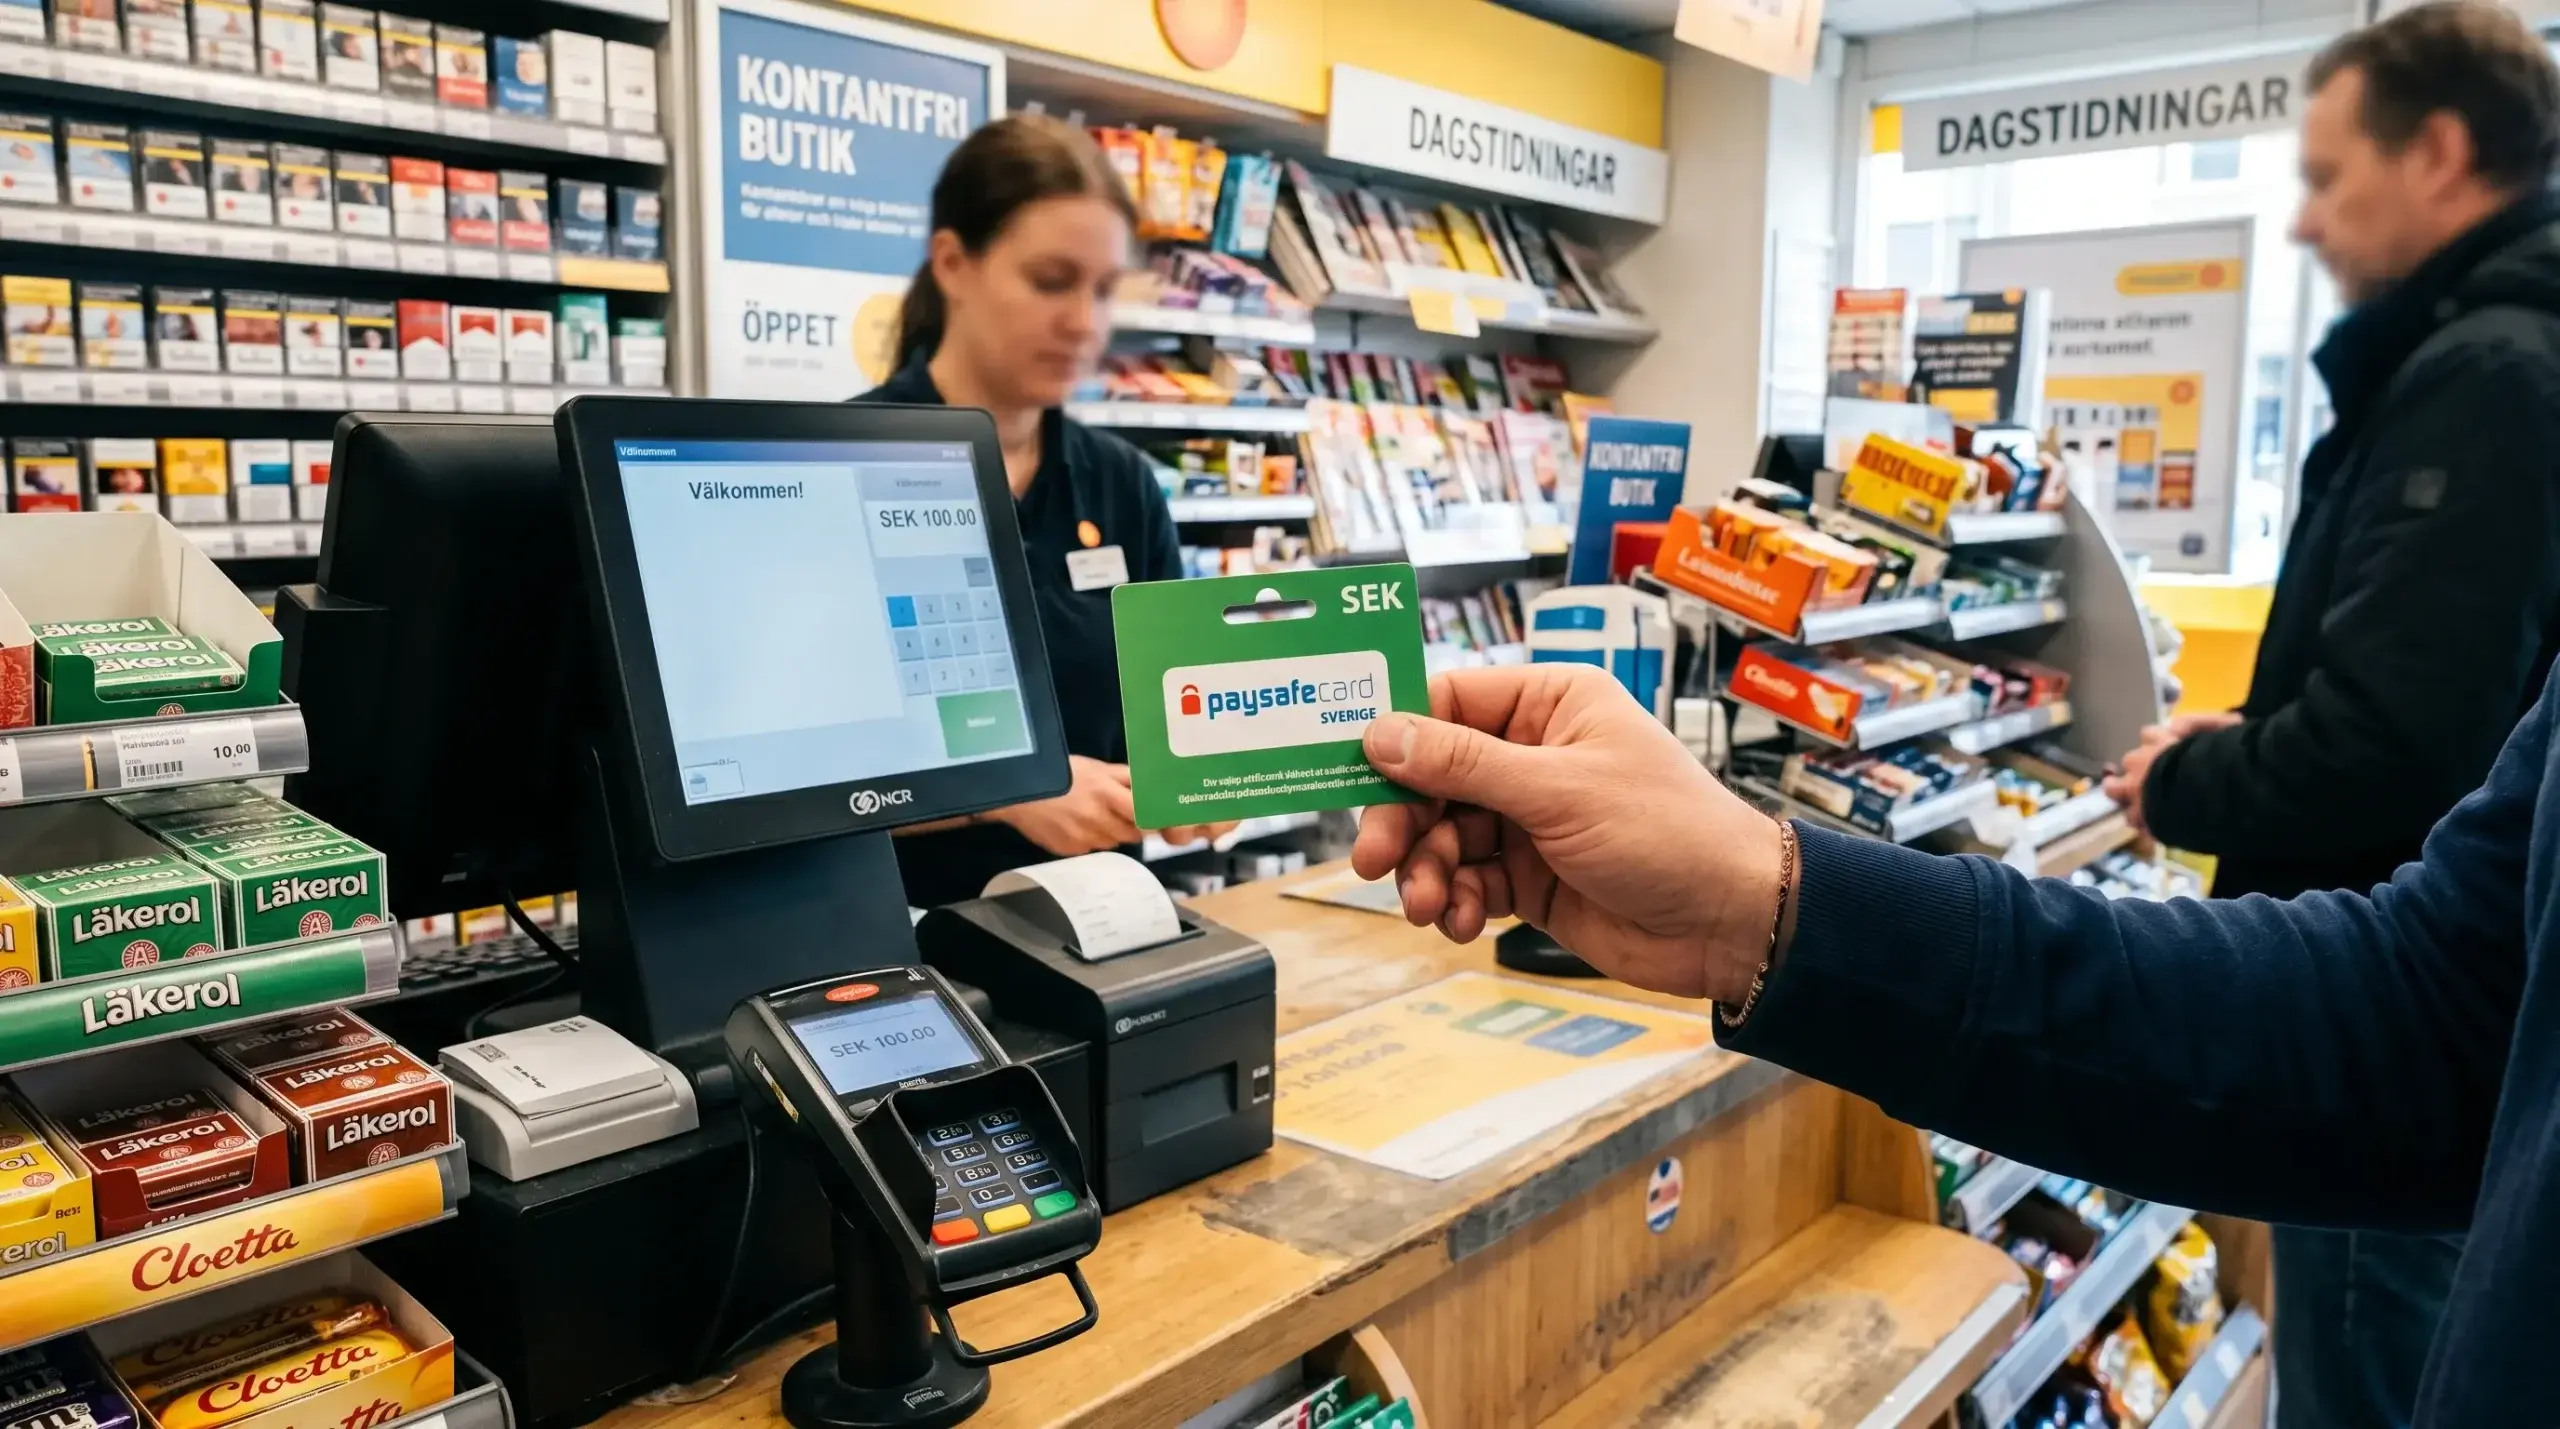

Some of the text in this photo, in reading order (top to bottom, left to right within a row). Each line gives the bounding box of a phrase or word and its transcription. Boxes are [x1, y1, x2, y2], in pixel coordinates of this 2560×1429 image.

[738, 54, 969, 140] KONTANTFRI
[1939, 77, 2290, 156] DAGSTIDNINGAR
[740, 112, 856, 176] BUTIK
[1409, 105, 1616, 195] DAGSTIDNINGAR
[743, 299, 838, 347] ÖPPET
[1589, 442, 1684, 472] KONTANTFRI
[688, 481, 804, 500] Välkommen!
[1609, 478, 1656, 506] BUTIK
[880, 508, 976, 528] SEK 100.00
[1341, 581, 1404, 614] SEK
[42, 619, 156, 638] äkerol
[94, 653, 217, 674] äkerol
[1208, 672, 1374, 720] paysafecard
[1321, 707, 1376, 724] SVERIGE
[213, 743, 251, 760] 10,00
[881, 789, 913, 807] NCR
[256, 870, 368, 912] Läkerol
[73, 896, 201, 943] Läkerol
[82, 972, 241, 1034] Läkerol
[236, 1019, 347, 1051] Läkerol
[830, 1026, 937, 1059] SEK 100.00
[284, 1054, 401, 1090] Läkerol
[79, 1093, 196, 1129] Läkerol
[326, 1099, 437, 1151] Läkerol
[988, 1115, 1001, 1126] 3
[100, 1120, 227, 1161] Läkerol
[937, 1128, 950, 1140] 2
[1002, 1135, 1014, 1146] 6
[951, 1148, 965, 1160] 5
[1014, 1155, 1027, 1166] 9
[965, 1169, 978, 1180] 8
[979, 1189, 992, 1201] 0
[0, 1231, 67, 1264] erol
[132, 1223, 300, 1292] Cloetta
[142, 1302, 319, 1366] Cloetta
[198, 1344, 378, 1414] Cloetta
